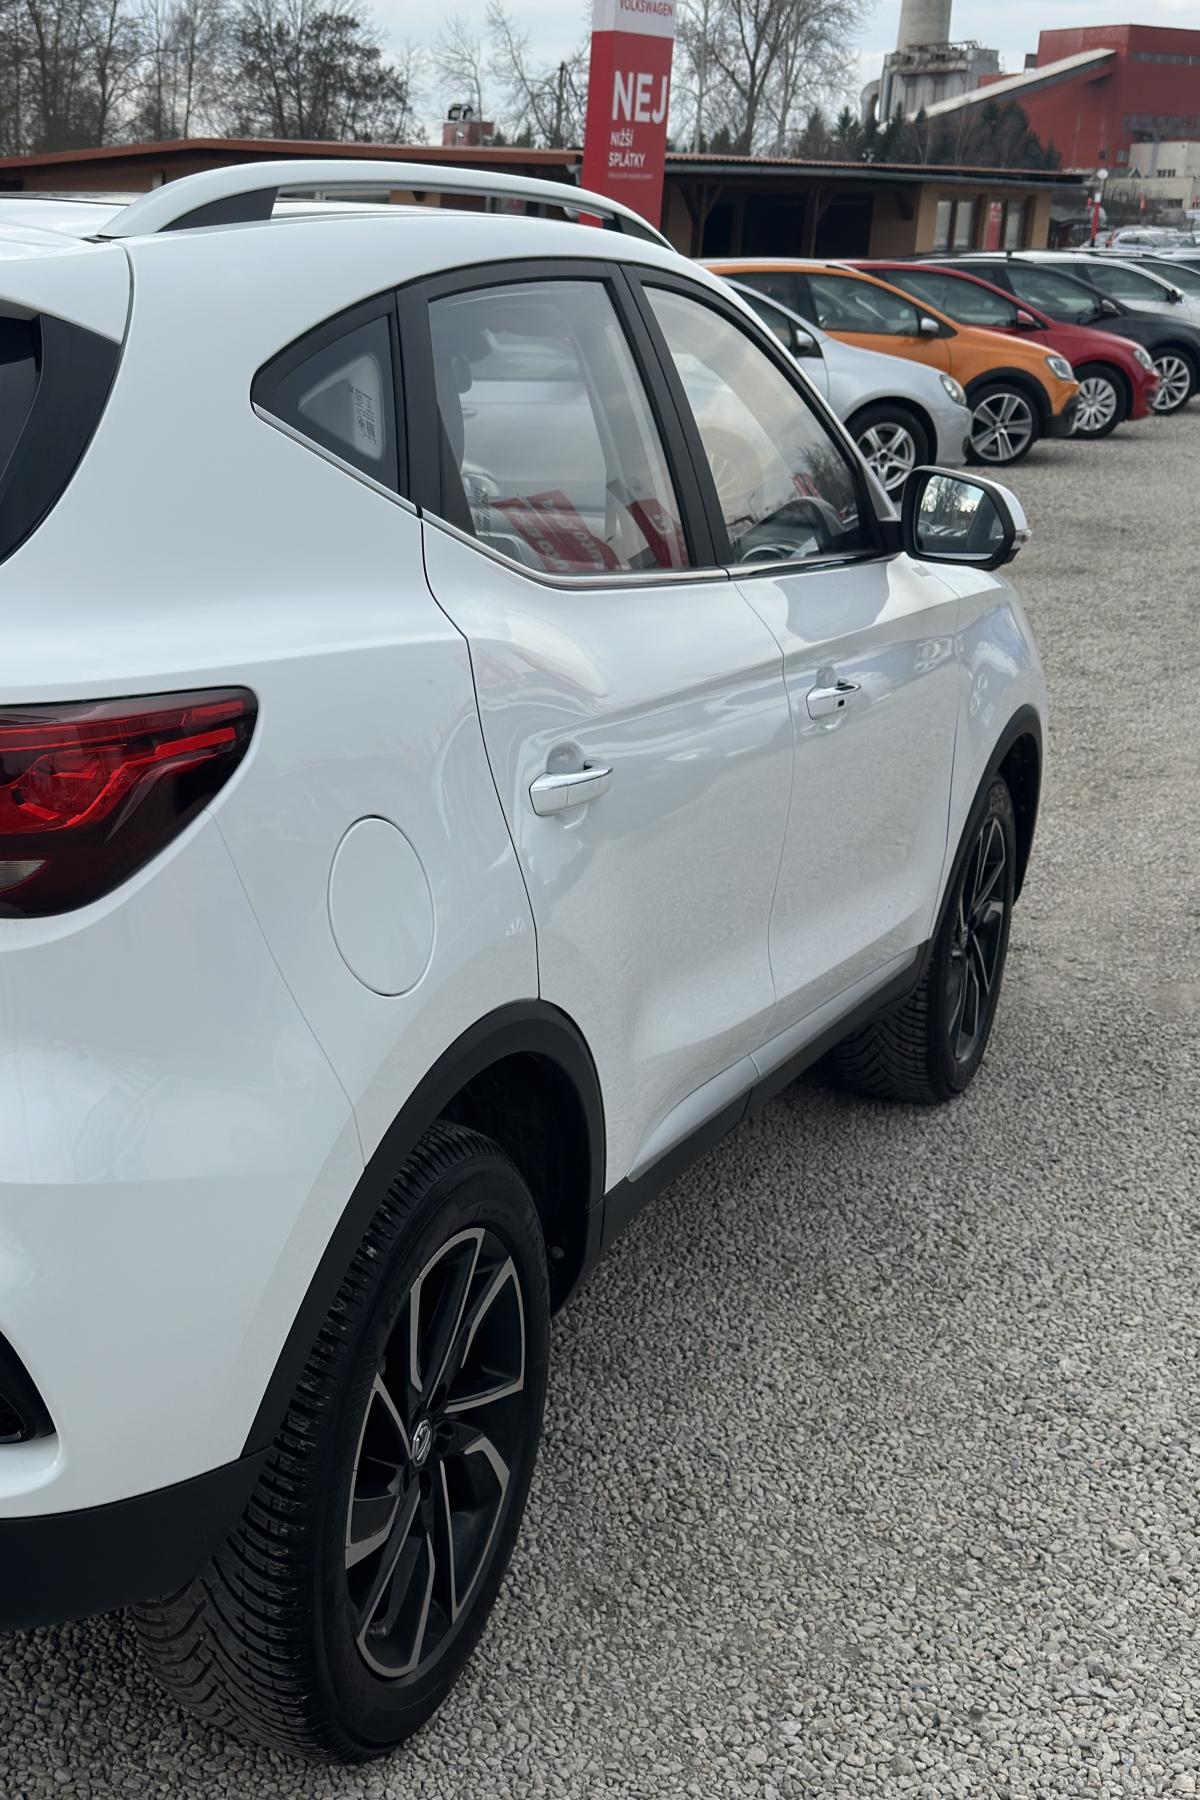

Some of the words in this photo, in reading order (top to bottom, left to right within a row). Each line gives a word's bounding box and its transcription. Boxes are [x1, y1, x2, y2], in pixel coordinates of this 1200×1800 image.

[618, 0, 673, 17] VOLKSWAGEN
[612, 70, 668, 125] NEJ
[608, 149, 646, 168] SPLÁTKY
